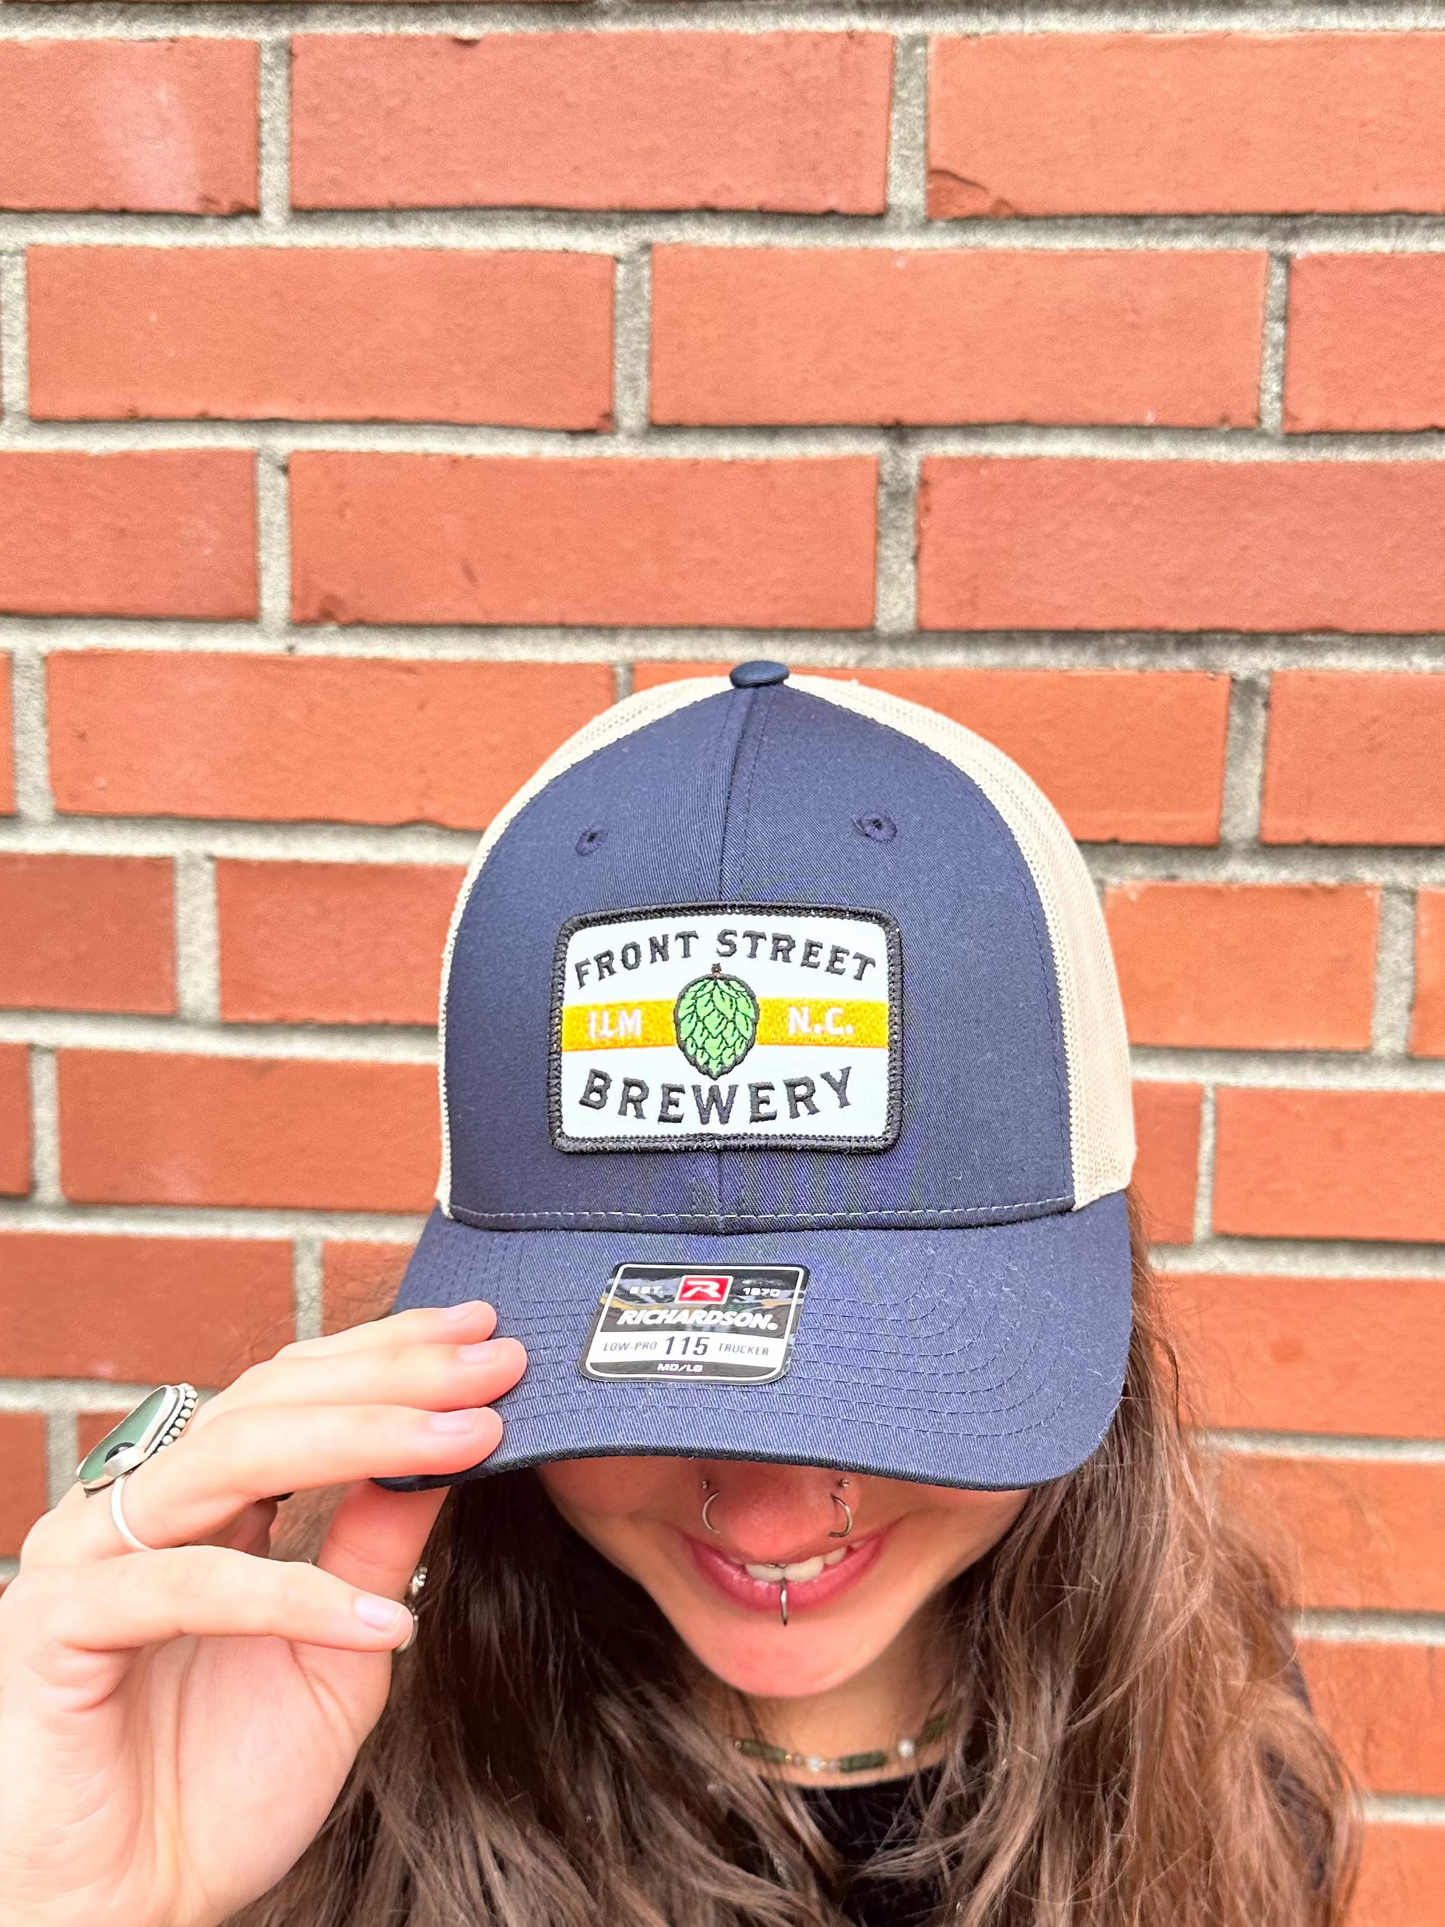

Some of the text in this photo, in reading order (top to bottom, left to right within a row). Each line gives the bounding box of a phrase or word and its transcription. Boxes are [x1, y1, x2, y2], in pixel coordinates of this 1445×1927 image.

[575, 928, 876, 989] FRONT STREET
[587, 1006, 854, 1039] ILM N.C.
[579, 1066, 852, 1125] BREWERY
[603, 1336, 769, 1356] LOW-PRO 115 TRUCKER
[657, 1363, 703, 1373] MD/LG
